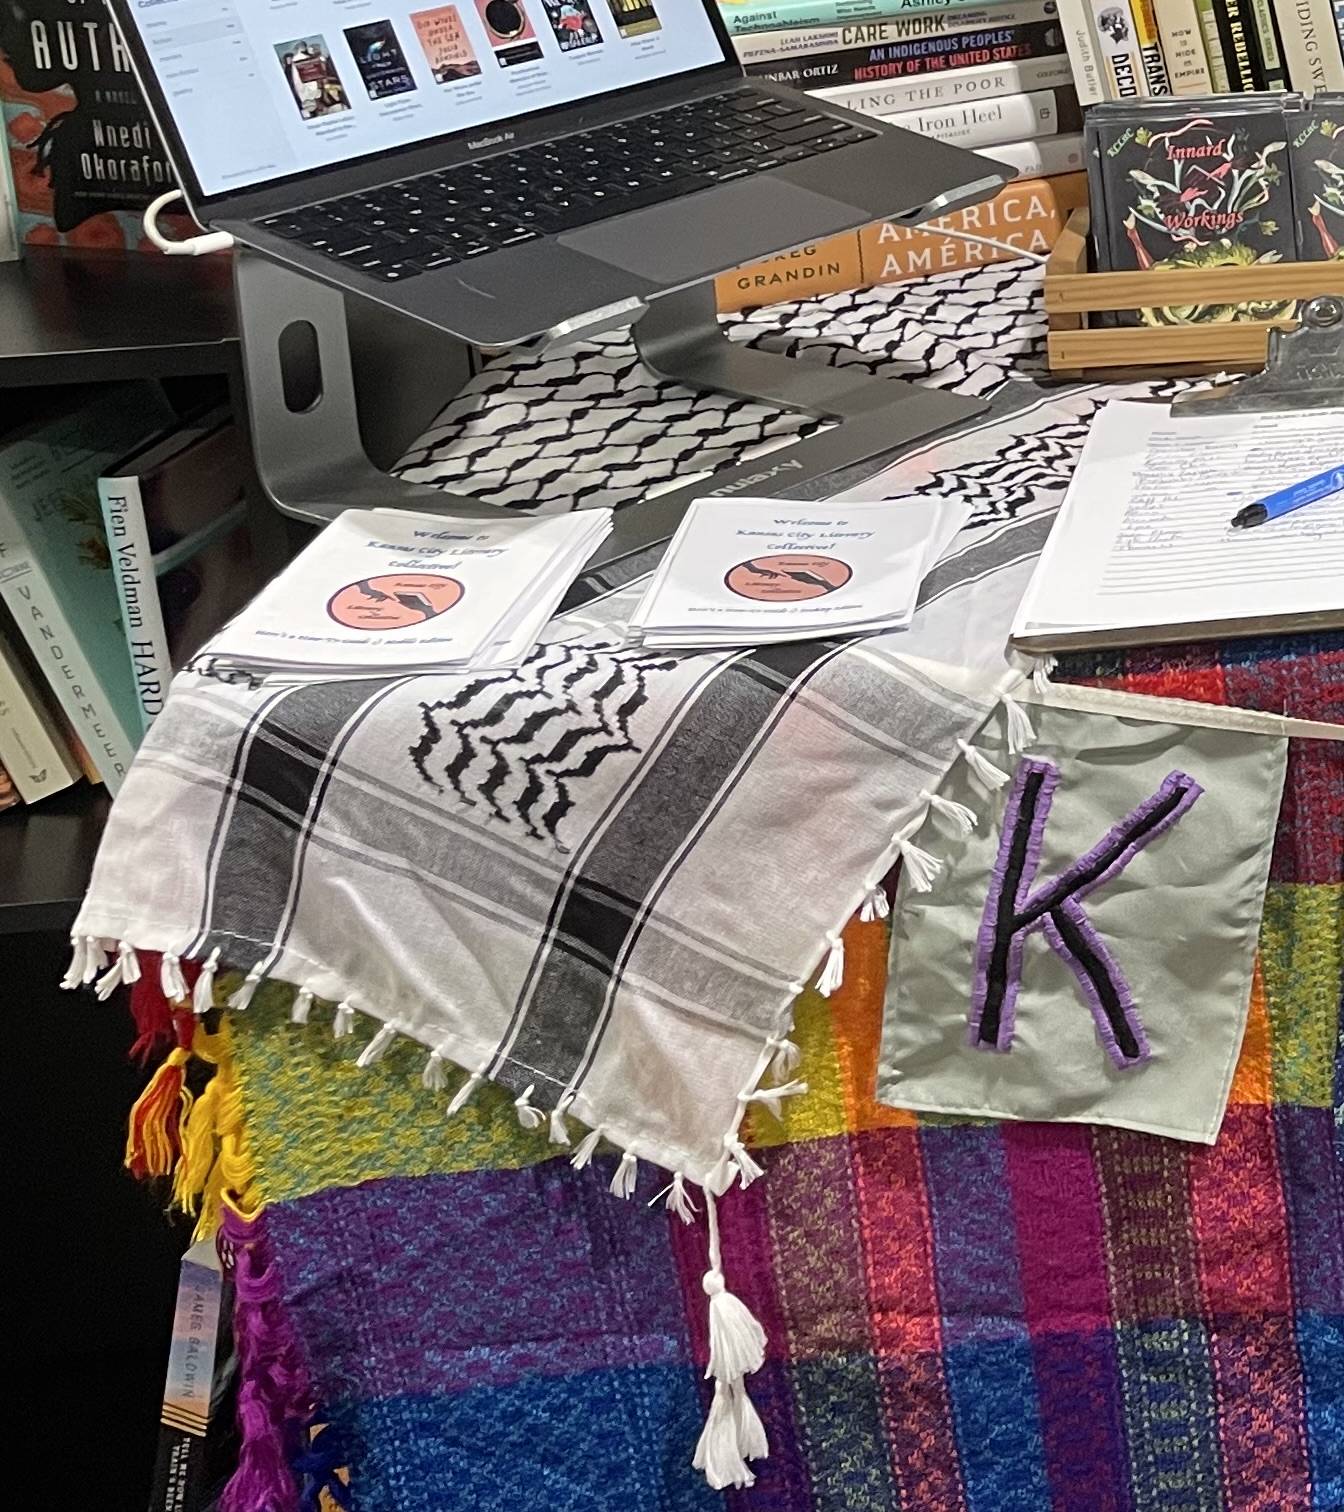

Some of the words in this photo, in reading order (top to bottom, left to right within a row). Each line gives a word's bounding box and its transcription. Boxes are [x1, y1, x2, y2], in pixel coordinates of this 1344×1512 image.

[733, 9, 777, 25] Against
[841, 22, 889, 47] CARE
[894, 15, 946, 40] WORK
[30, 20, 131, 73] AUTH
[869, 48, 886, 62] AN
[887, 38, 960, 60] INDIGENOUS
[1175, 48, 1196, 57] HIDE
[802, 64, 839, 78] ORTIZ
[854, 62, 900, 82] HISTORY
[901, 61, 921, 75] OF
[924, 56, 947, 71] THE
[949, 50, 991, 68] UNITED
[993, 44, 1032, 62] STATES
[1075, 29, 1091, 62] Judith
[1083, 64, 1098, 97] Butler
[1174, 67, 1206, 79] EMPIRE
[905, 87, 945, 103] THE
[953, 75, 1006, 95] POOR
[918, 110, 956, 132] Iron
[962, 105, 1003, 126] Heel
[94, 119, 152, 149] Nnedi
[1165, 139, 1226, 162] Innard
[1164, 209, 1244, 232] Workings
[737, 262, 841, 290] GRANDIN
[708, 458, 804, 497] nulaxy
[107, 494, 129, 538] Fien
[773, 518, 832, 526] Welcome
[735, 529, 785, 538] Kansas
[786, 530, 816, 540] City
[116, 543, 144, 630] Veldman
[17, 585, 127, 778] VANDERMEER
[180, 1336, 200, 1399] BALDWIN
